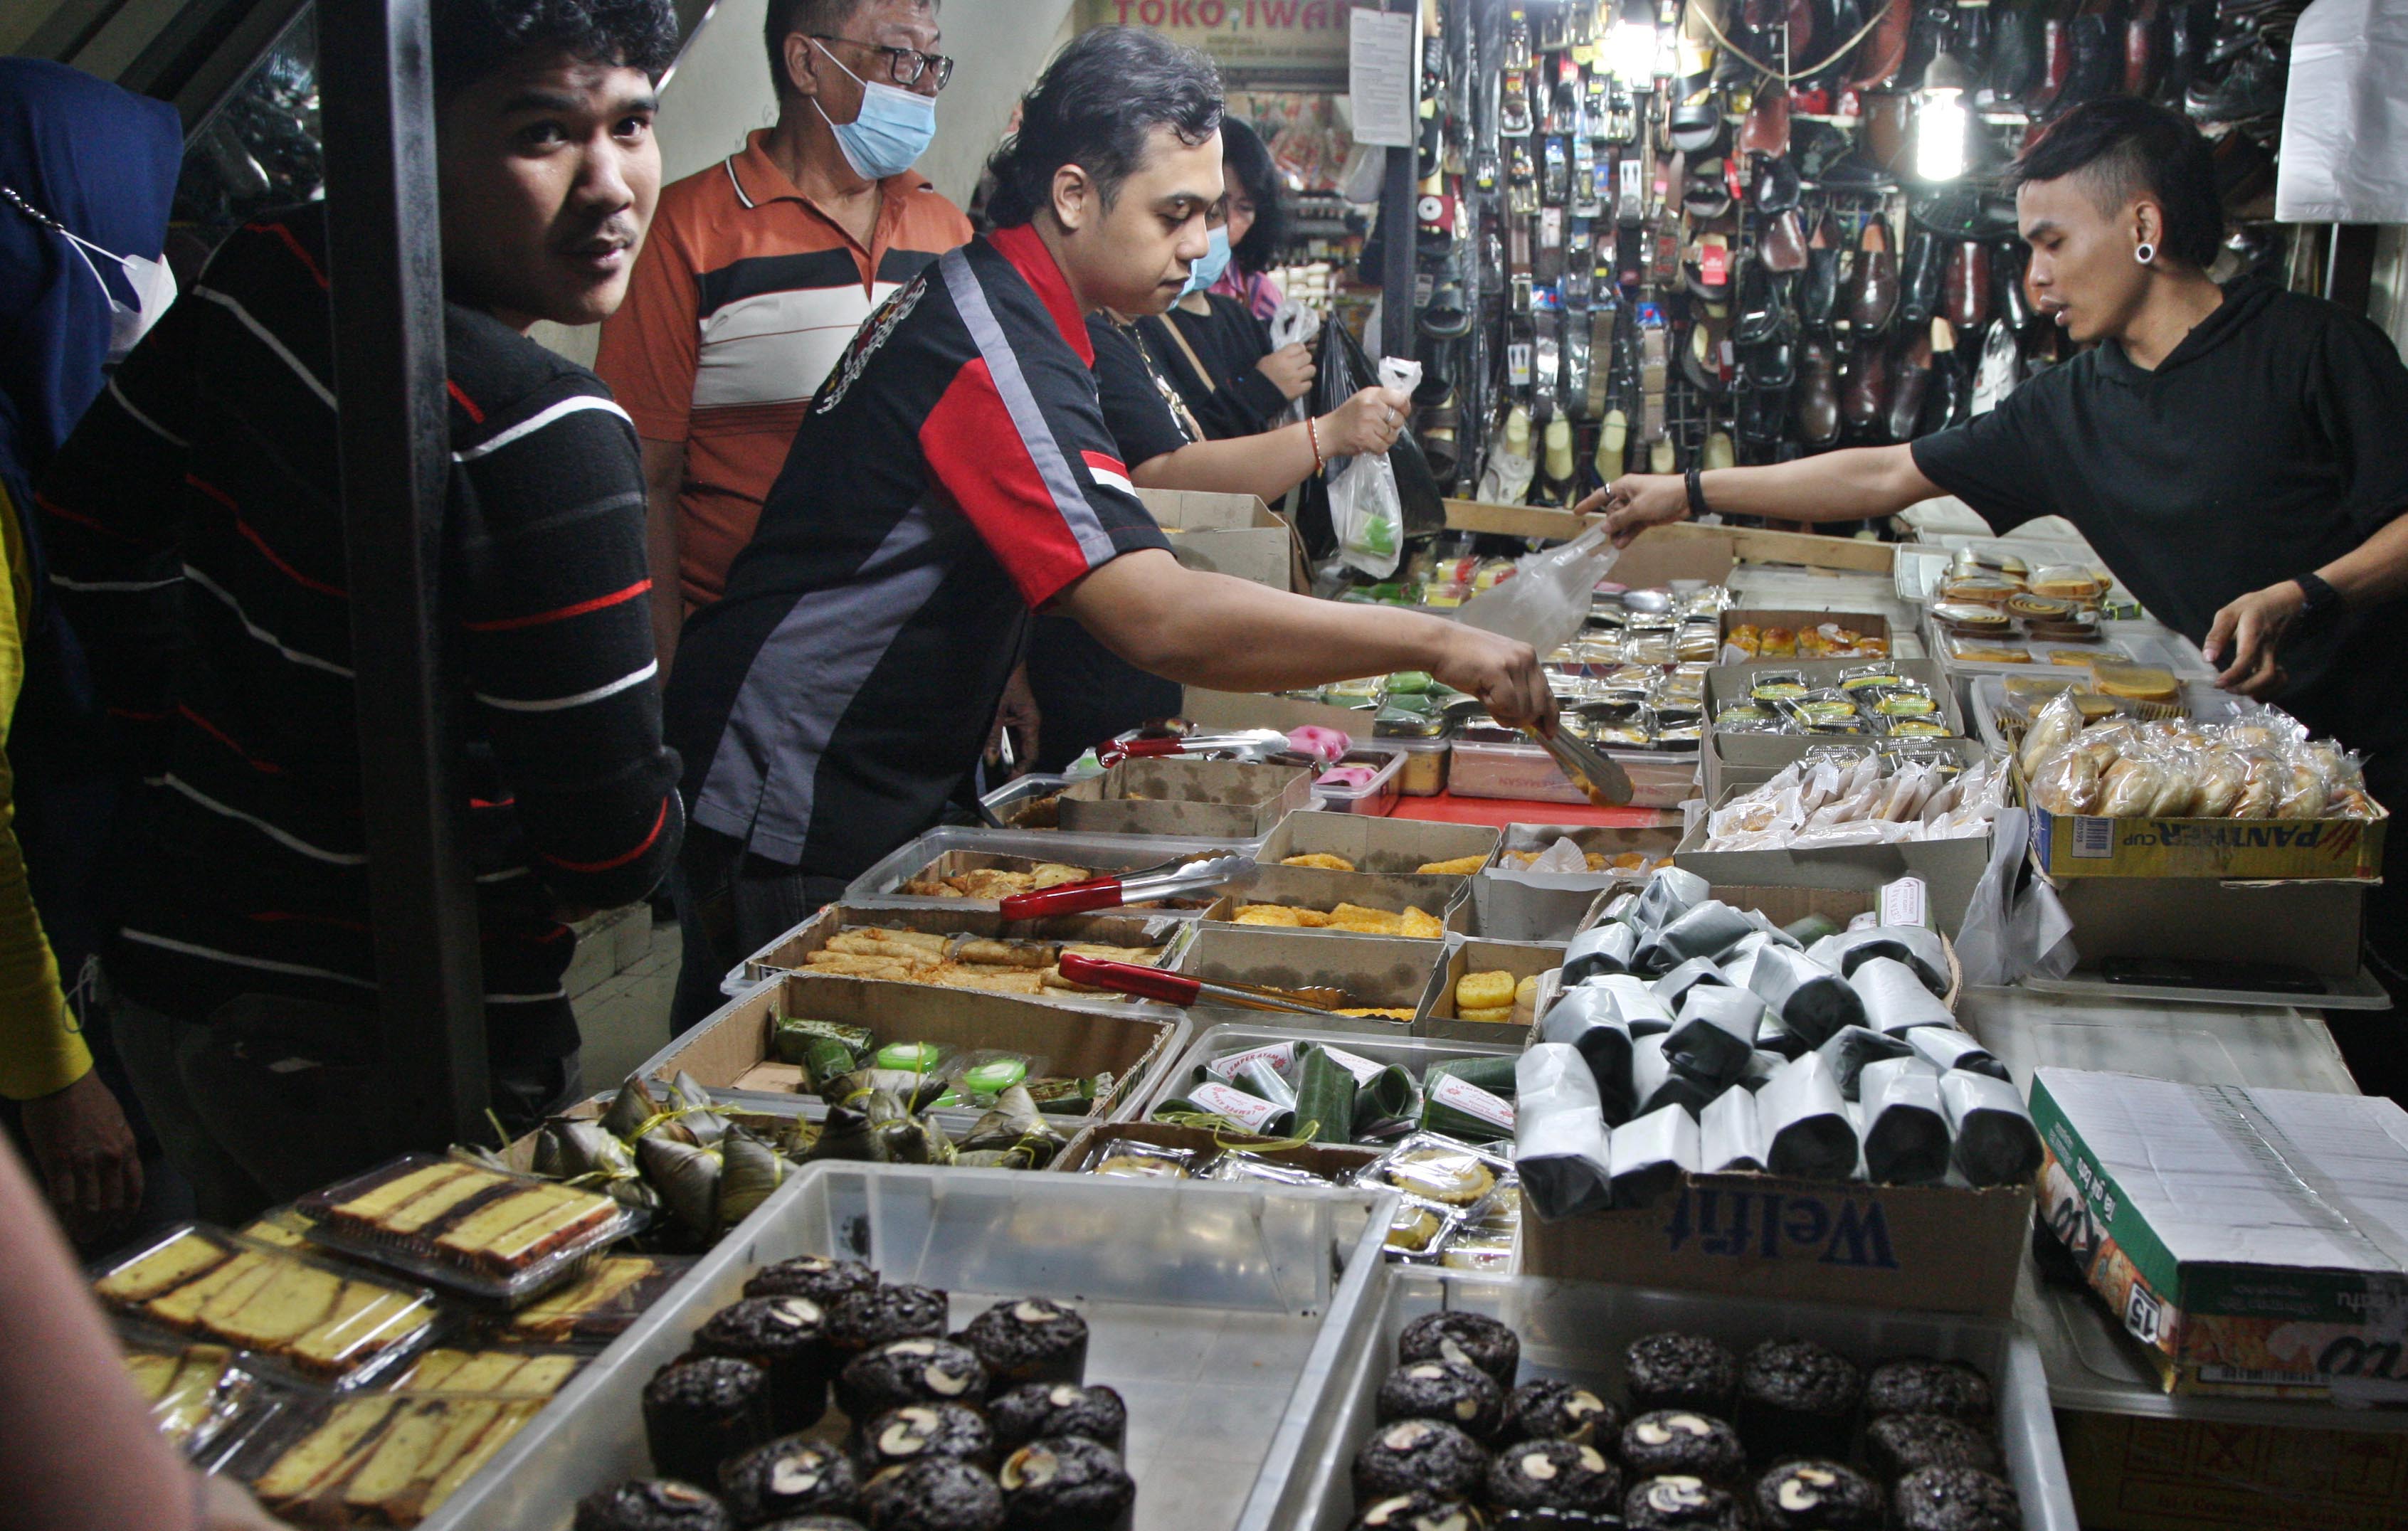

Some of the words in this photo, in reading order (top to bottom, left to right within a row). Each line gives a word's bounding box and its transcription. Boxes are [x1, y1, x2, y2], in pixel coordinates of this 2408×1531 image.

[1113, 0, 1225, 27] TOKO
[2123, 833, 2158, 847] CUP
[1226, 1054, 1255, 1076] LEMPER
[1223, 1104, 1256, 1116] LEMPER
[1664, 1188, 1899, 1268] Welfit
[2130, 1298, 2154, 1337] 15
